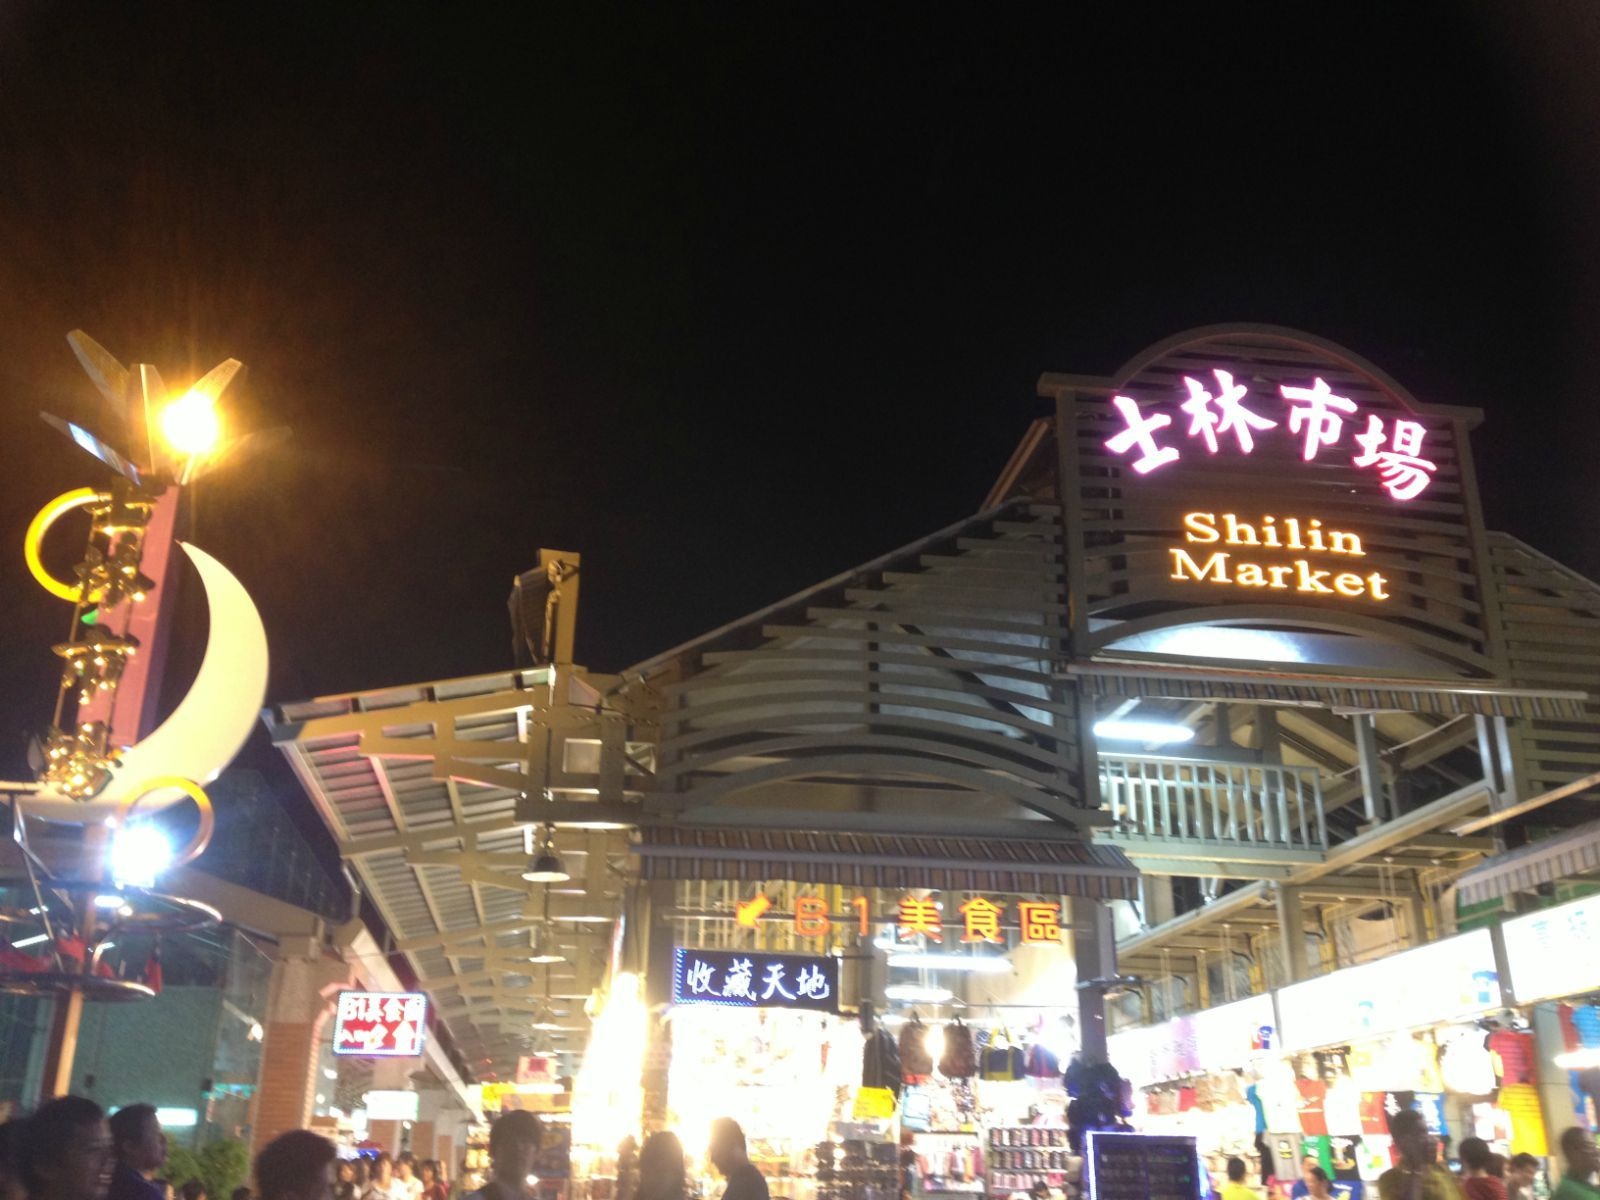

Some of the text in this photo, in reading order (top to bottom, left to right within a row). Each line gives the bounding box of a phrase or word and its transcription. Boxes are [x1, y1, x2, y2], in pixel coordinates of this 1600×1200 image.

[1105, 368, 1437, 500] 士林市場
[1184, 511, 1366, 556] Shilin
[1169, 548, 1390, 600] Market
[687, 957, 831, 1002] 收藏天地
